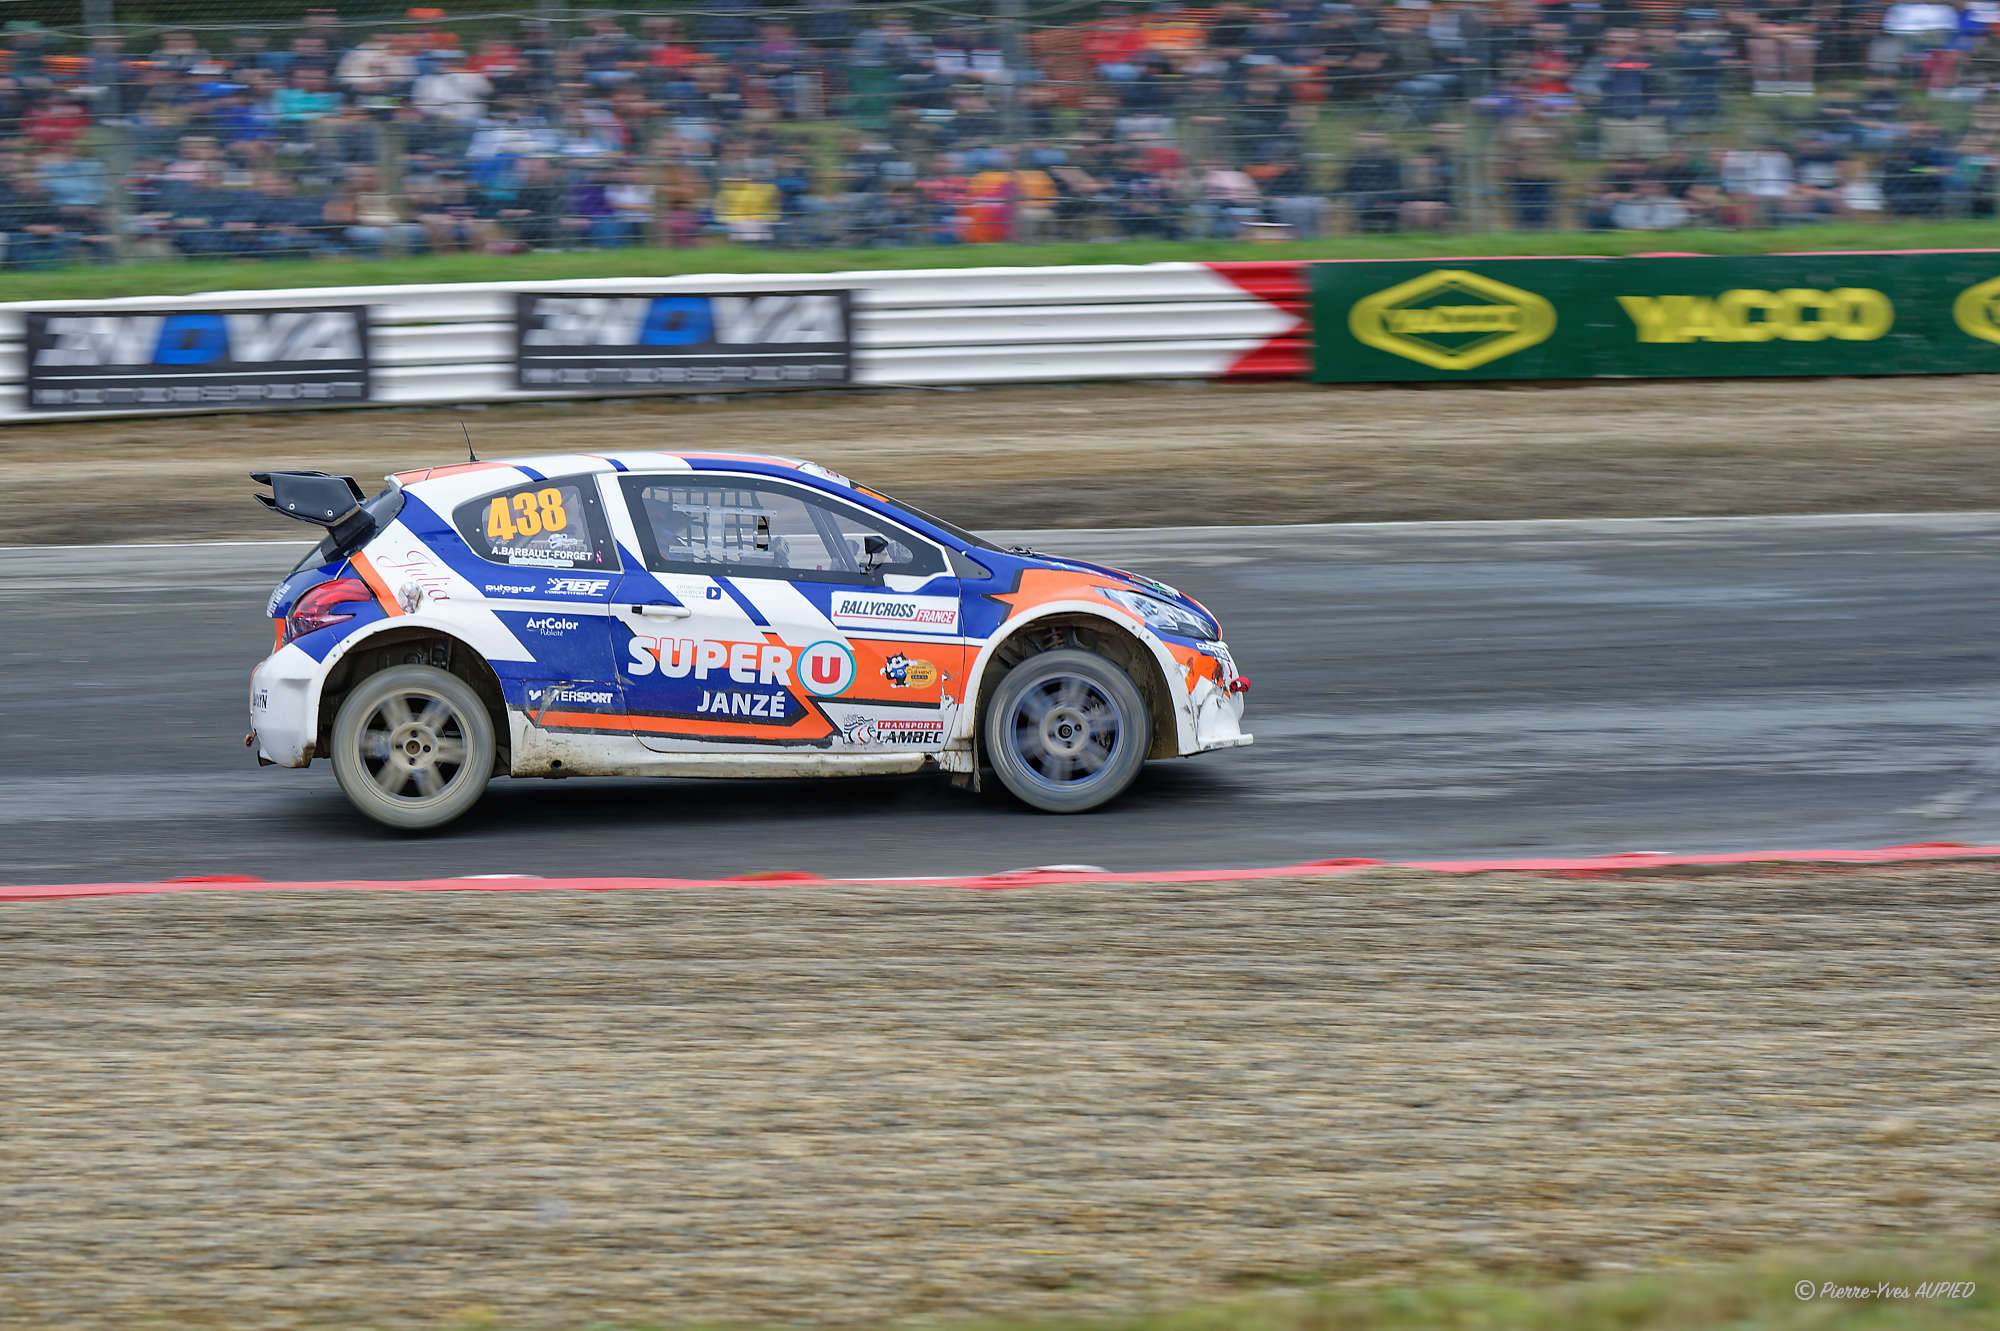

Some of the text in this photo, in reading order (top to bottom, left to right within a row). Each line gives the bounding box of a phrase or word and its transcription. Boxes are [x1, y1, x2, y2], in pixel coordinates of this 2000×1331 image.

[1616, 287, 1894, 343] YACCO
[488, 488, 567, 540] 438
[491, 546, 593, 561] A.BARBAULT-FORGET
[840, 600, 955, 624] RALLYCROSS FRANCE
[526, 617, 579, 630] ArtColor
[628, 635, 841, 686] SUPER U
[542, 689, 614, 704] ERSPORT
[696, 691, 786, 718] JANZÉ
[880, 720, 943, 729] TRANSPORTS
[877, 731, 944, 744] LAMBEC
